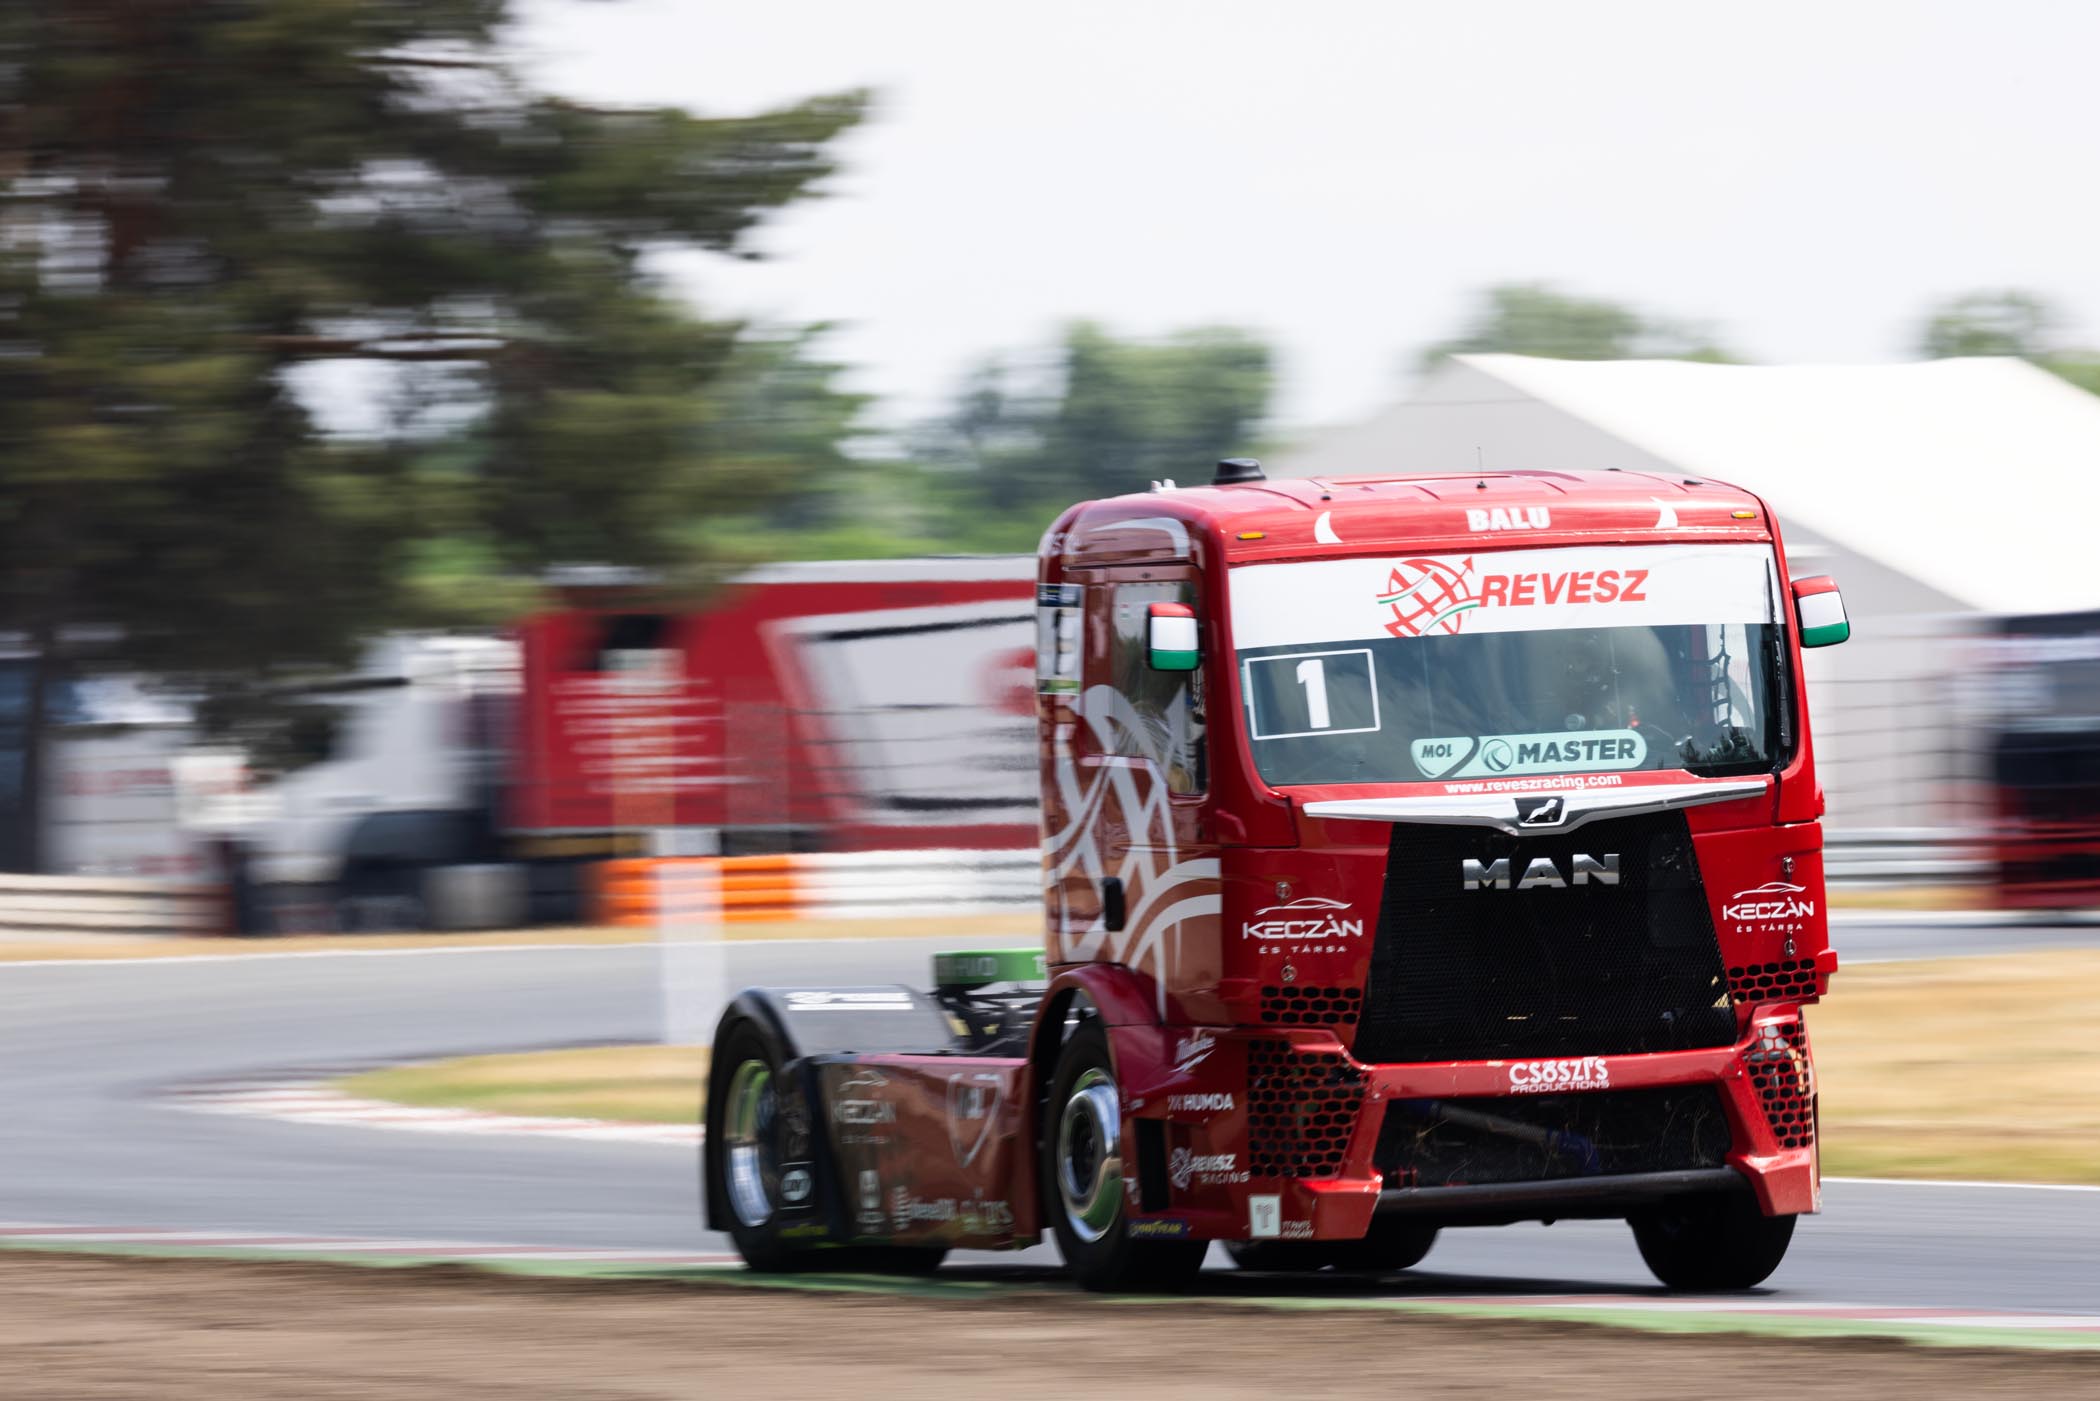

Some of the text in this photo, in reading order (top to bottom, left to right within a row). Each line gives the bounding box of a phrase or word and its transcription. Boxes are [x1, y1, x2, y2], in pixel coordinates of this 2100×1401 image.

[1466, 507, 1551, 532] BALU
[1479, 569, 1649, 607] REVESZ
[1296, 659, 1331, 728] 1
[1421, 738, 1637, 764] MOL MASTER
[1444, 774, 1622, 794] www.reveszracing.com
[1462, 853, 1620, 889] MAN
[1510, 1079, 1610, 1095] PRODUCTIONS
[1183, 1093, 1235, 1111] HUMDA
